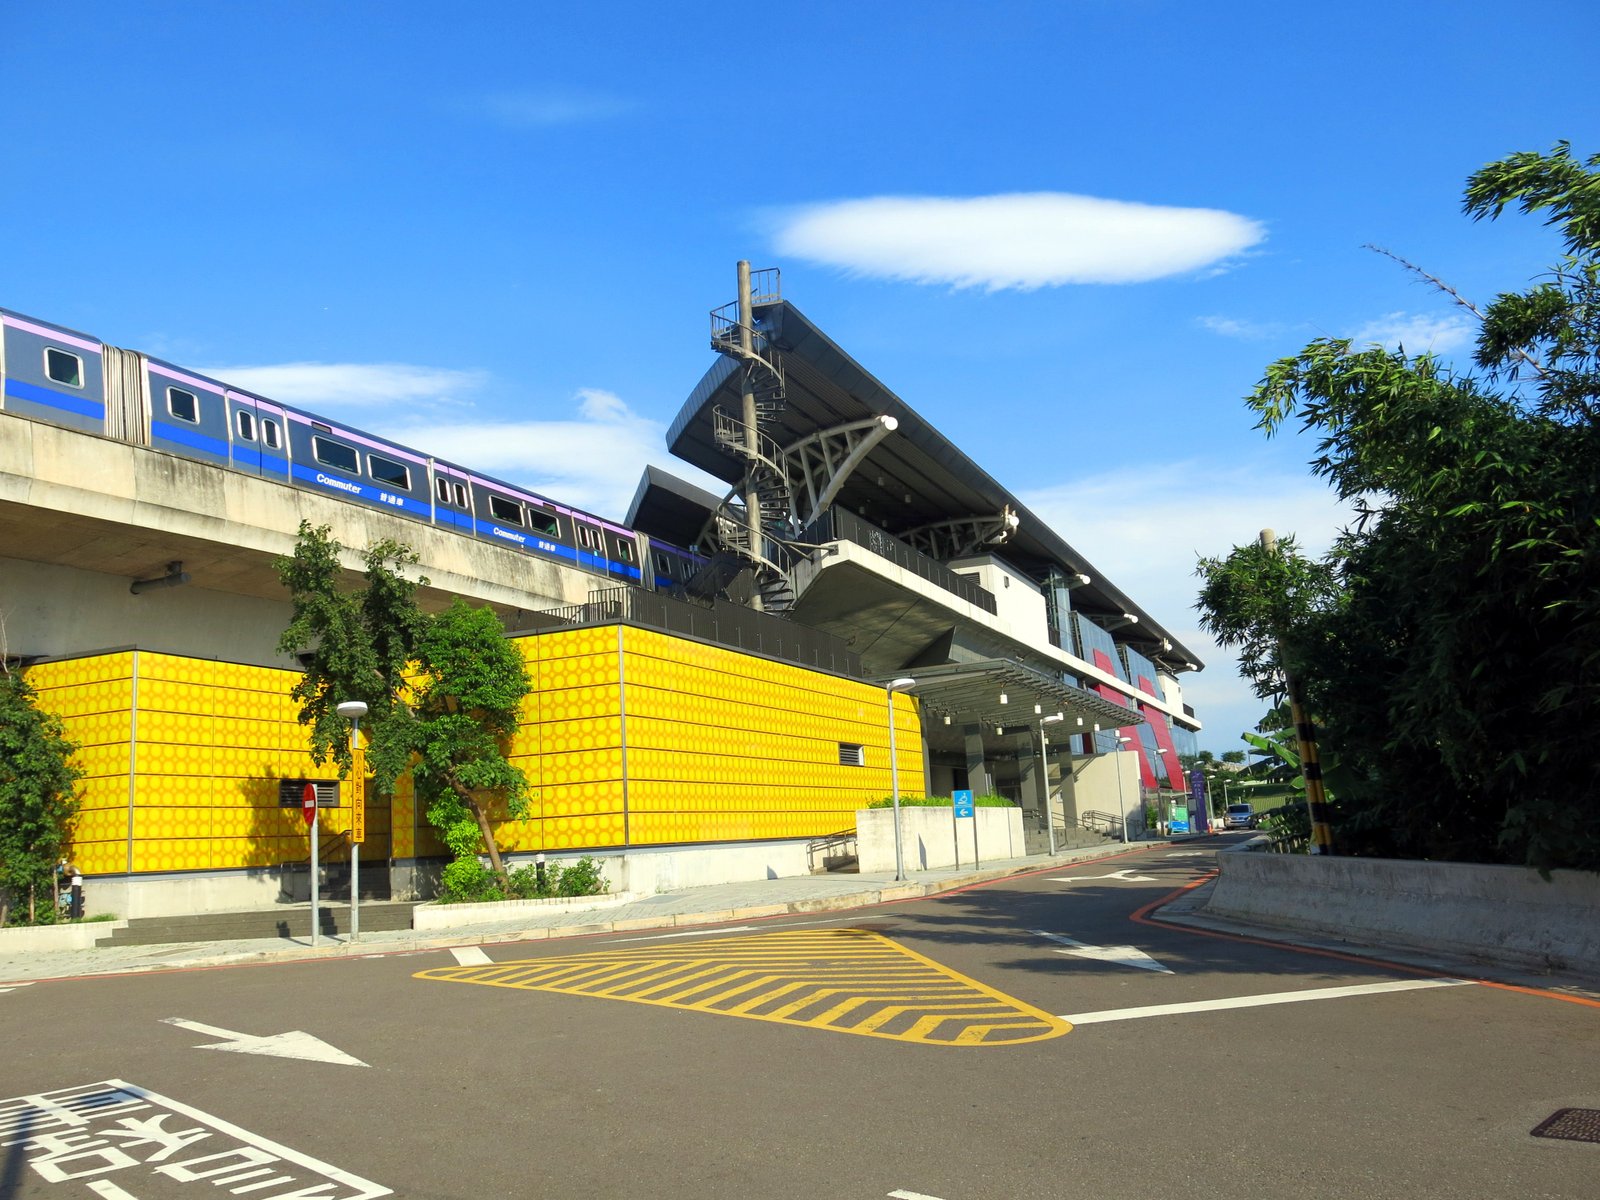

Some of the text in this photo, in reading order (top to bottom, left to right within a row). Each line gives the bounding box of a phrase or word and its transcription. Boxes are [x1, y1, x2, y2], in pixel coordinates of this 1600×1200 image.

[316, 473, 362, 494] Commuter
[379, 492, 404, 506] 普通車
[493, 527, 526, 543] Commuter
